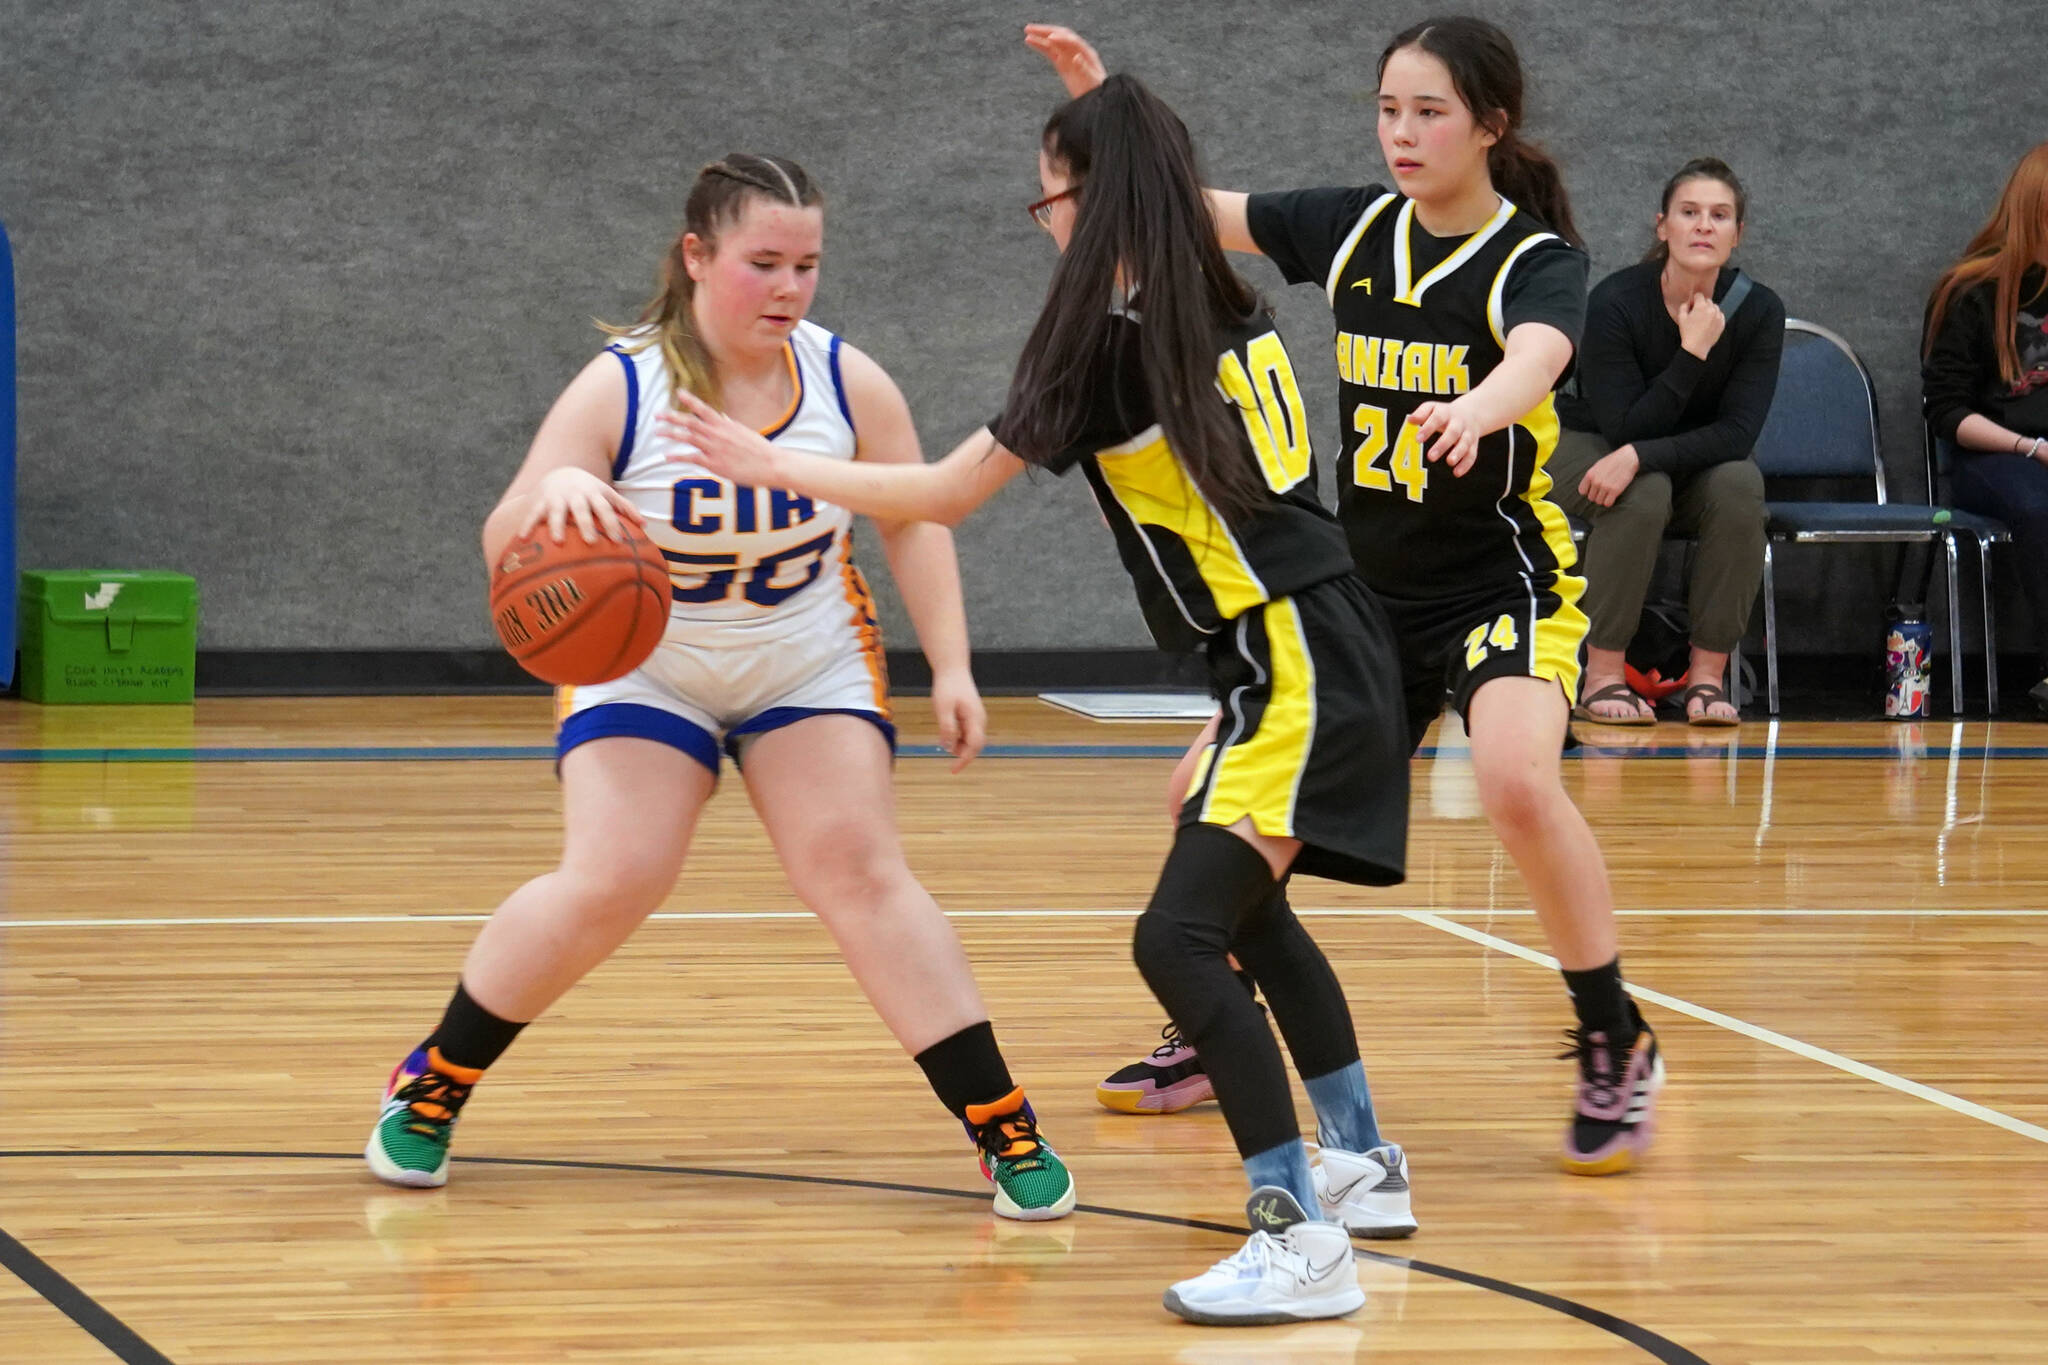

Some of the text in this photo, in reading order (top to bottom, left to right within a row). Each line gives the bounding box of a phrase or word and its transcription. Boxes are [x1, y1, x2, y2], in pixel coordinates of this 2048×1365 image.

[1336, 330, 1470, 395] ANIAK
[1213, 330, 1313, 496] 10
[1353, 403, 1429, 504] 24
[671, 475, 816, 536] CIA
[1463, 613, 1519, 672] 24
